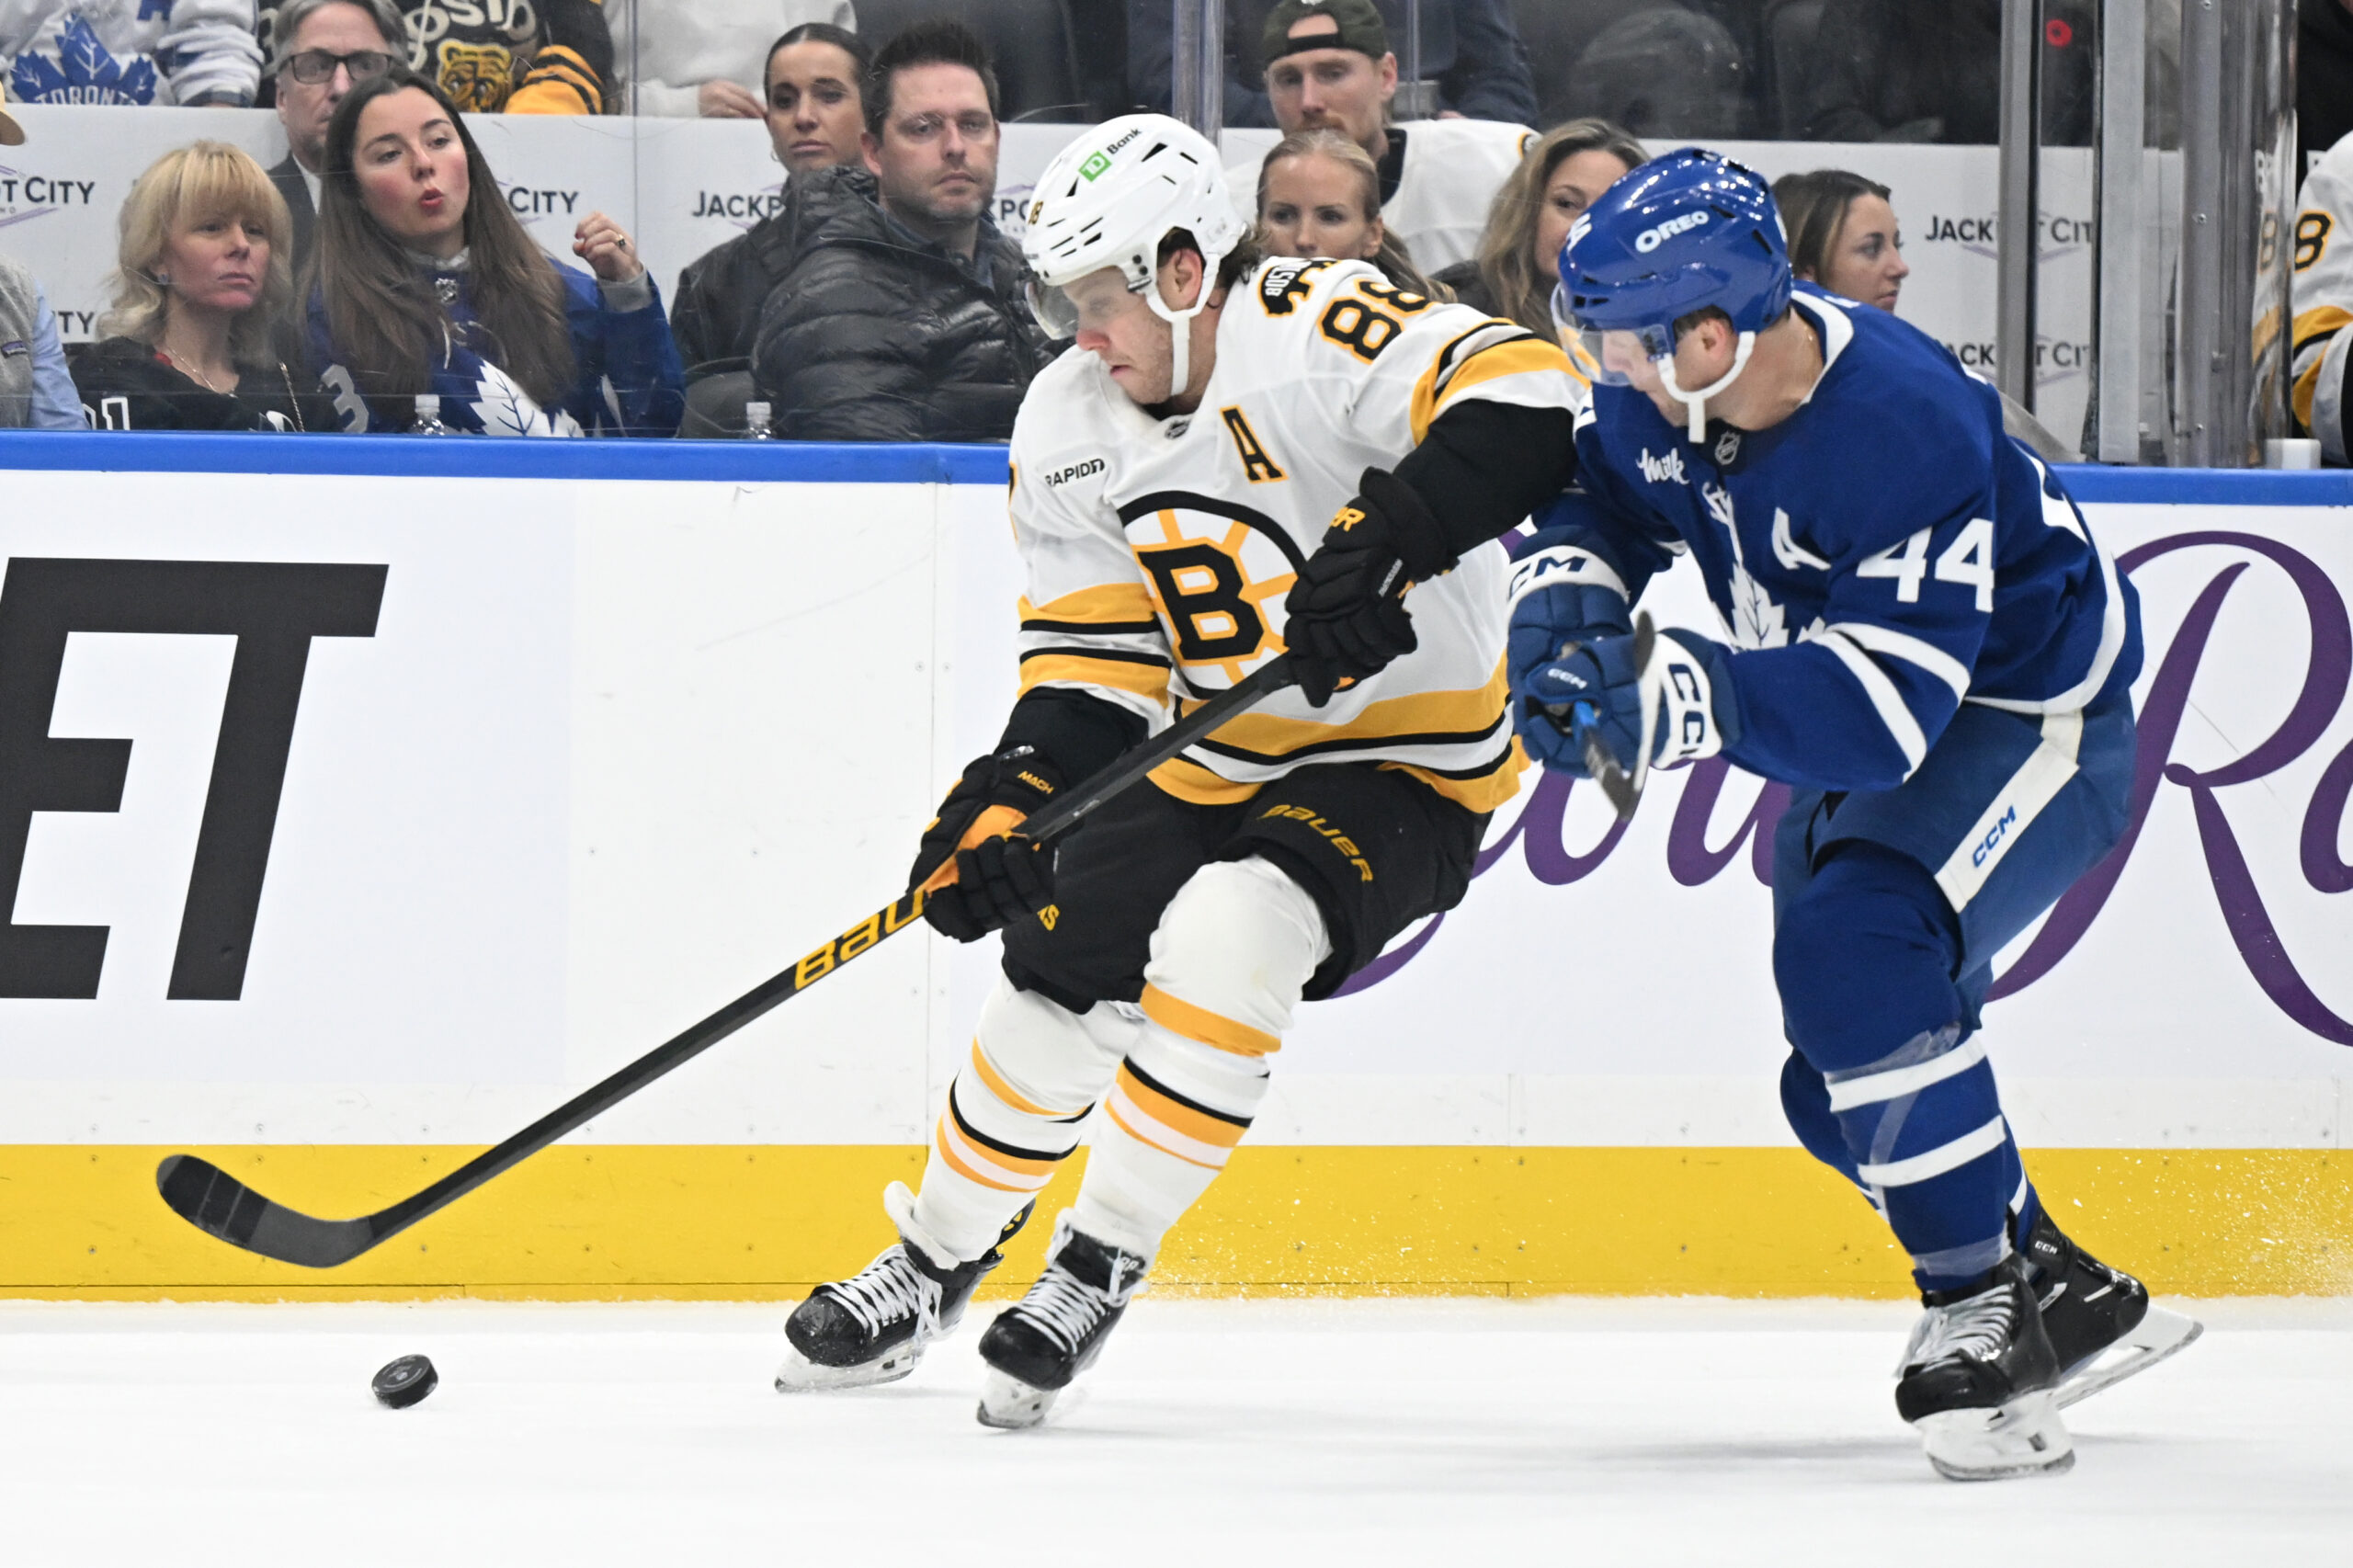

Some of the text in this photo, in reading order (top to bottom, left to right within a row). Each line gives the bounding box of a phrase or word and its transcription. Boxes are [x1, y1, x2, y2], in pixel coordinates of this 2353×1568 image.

[1107, 128, 1142, 154] Bank
[25, 176, 95, 204] CITY
[508, 187, 579, 213] CITY
[691, 190, 786, 219] JACKP
[1635, 210, 1709, 253] OREO
[1926, 215, 2093, 243] JACK CIT
[1316, 278, 1443, 365] 88
[1220, 404, 1290, 484] A
[1509, 555, 1587, 600] CM
[1856, 517, 1995, 614] 44
[1131, 537, 1270, 666] B
[1548, 668, 1587, 689] CCM
[1668, 663, 1705, 756] CC
[1017, 770, 1054, 795] MACH
[1972, 804, 2017, 869] CCM
[795, 888, 926, 991] BAU
[2034, 1240, 2058, 1255] CCM
